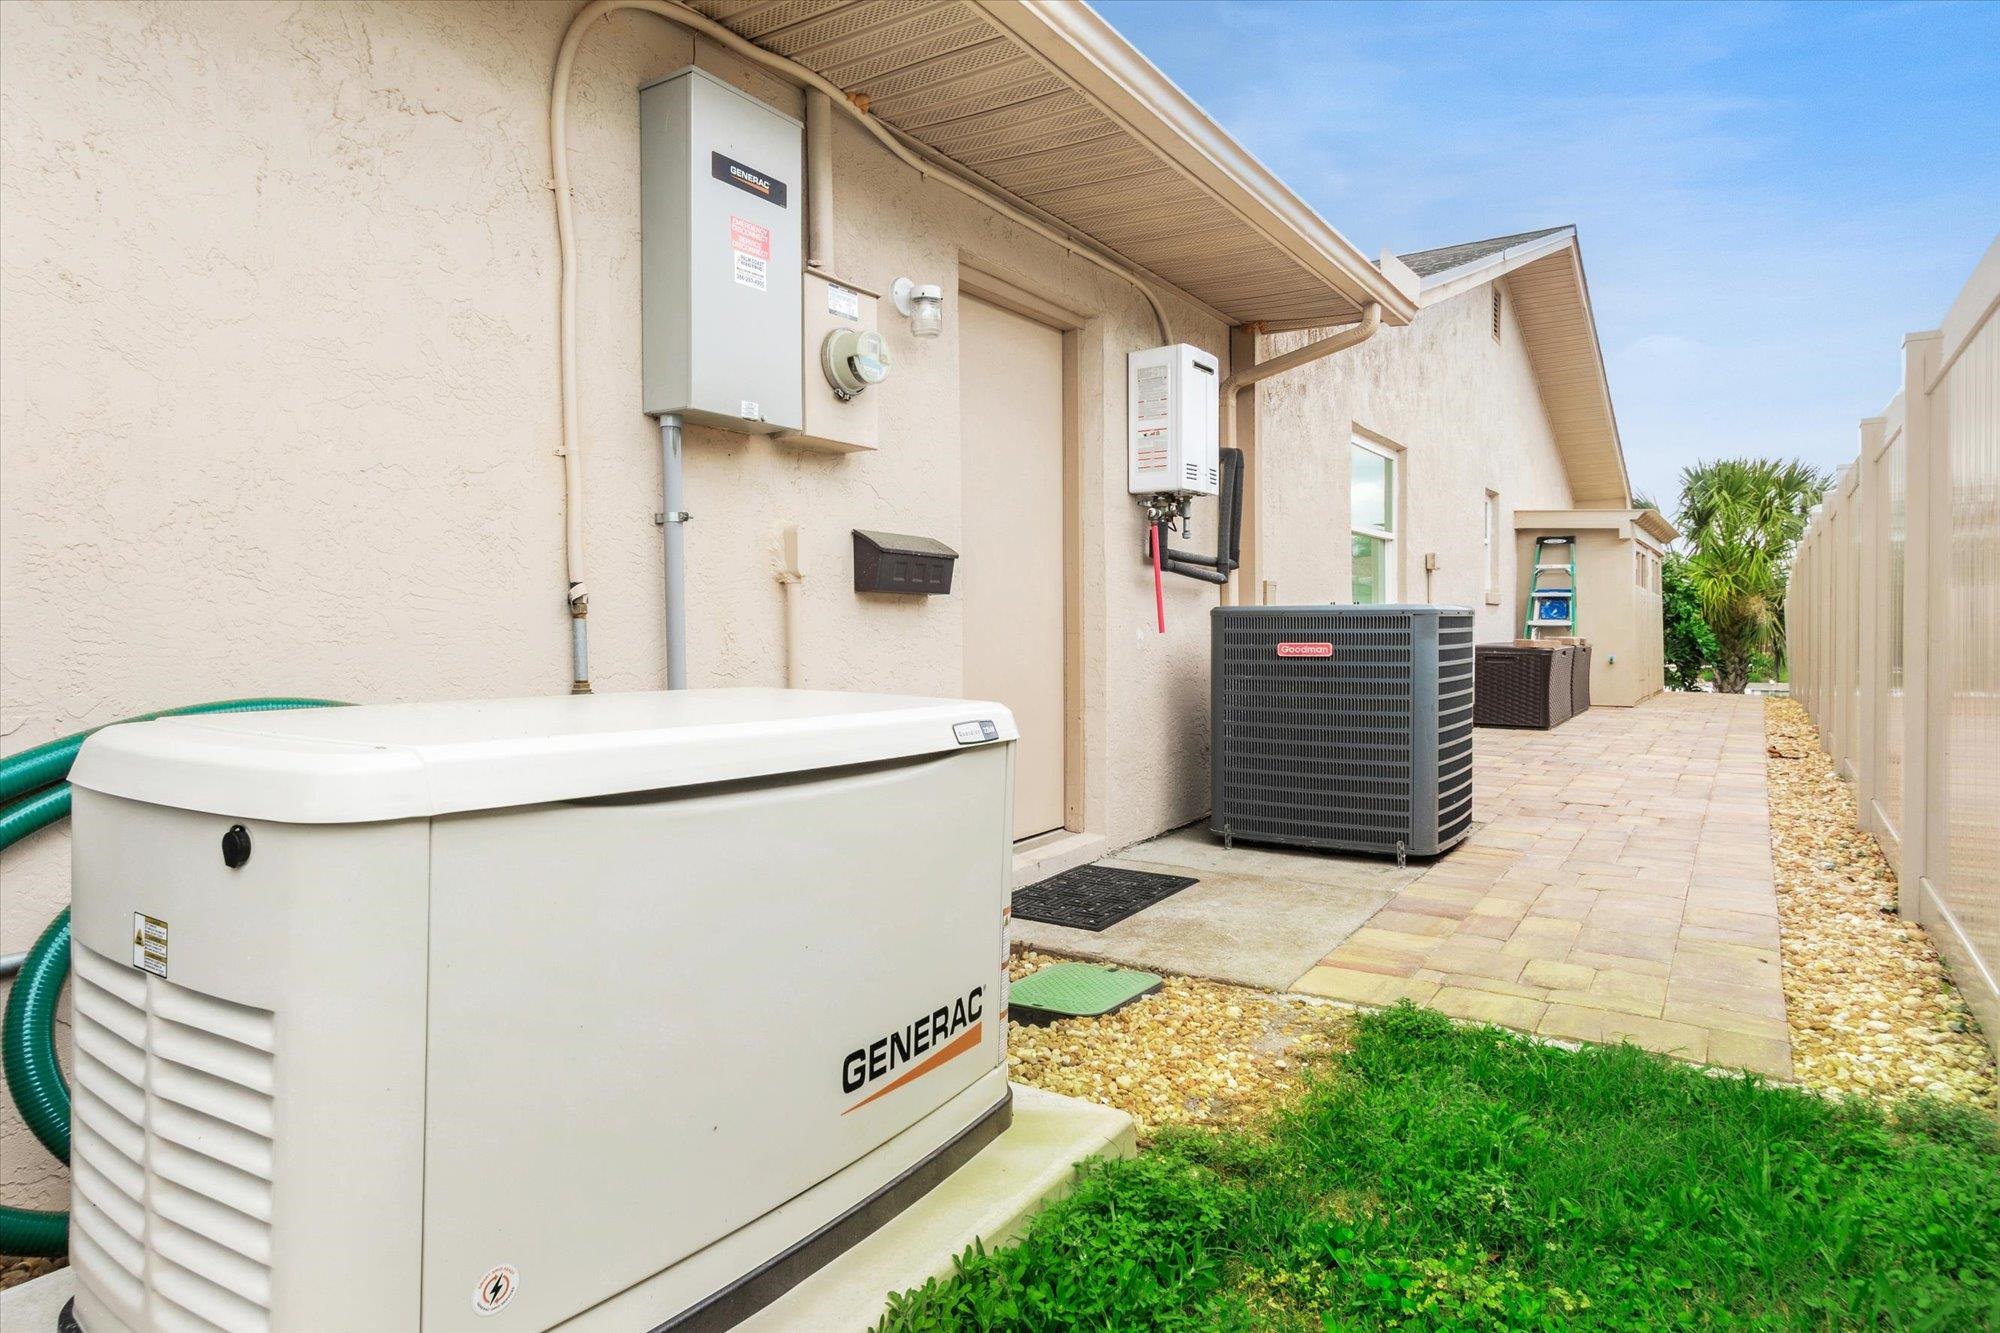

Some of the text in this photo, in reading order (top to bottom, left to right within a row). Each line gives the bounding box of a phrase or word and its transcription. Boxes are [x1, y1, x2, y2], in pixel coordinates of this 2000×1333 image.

[730, 165, 770, 189] GENERAC
[1281, 645, 1329, 653] Goodman
[843, 986, 982, 1094] GENERAC
